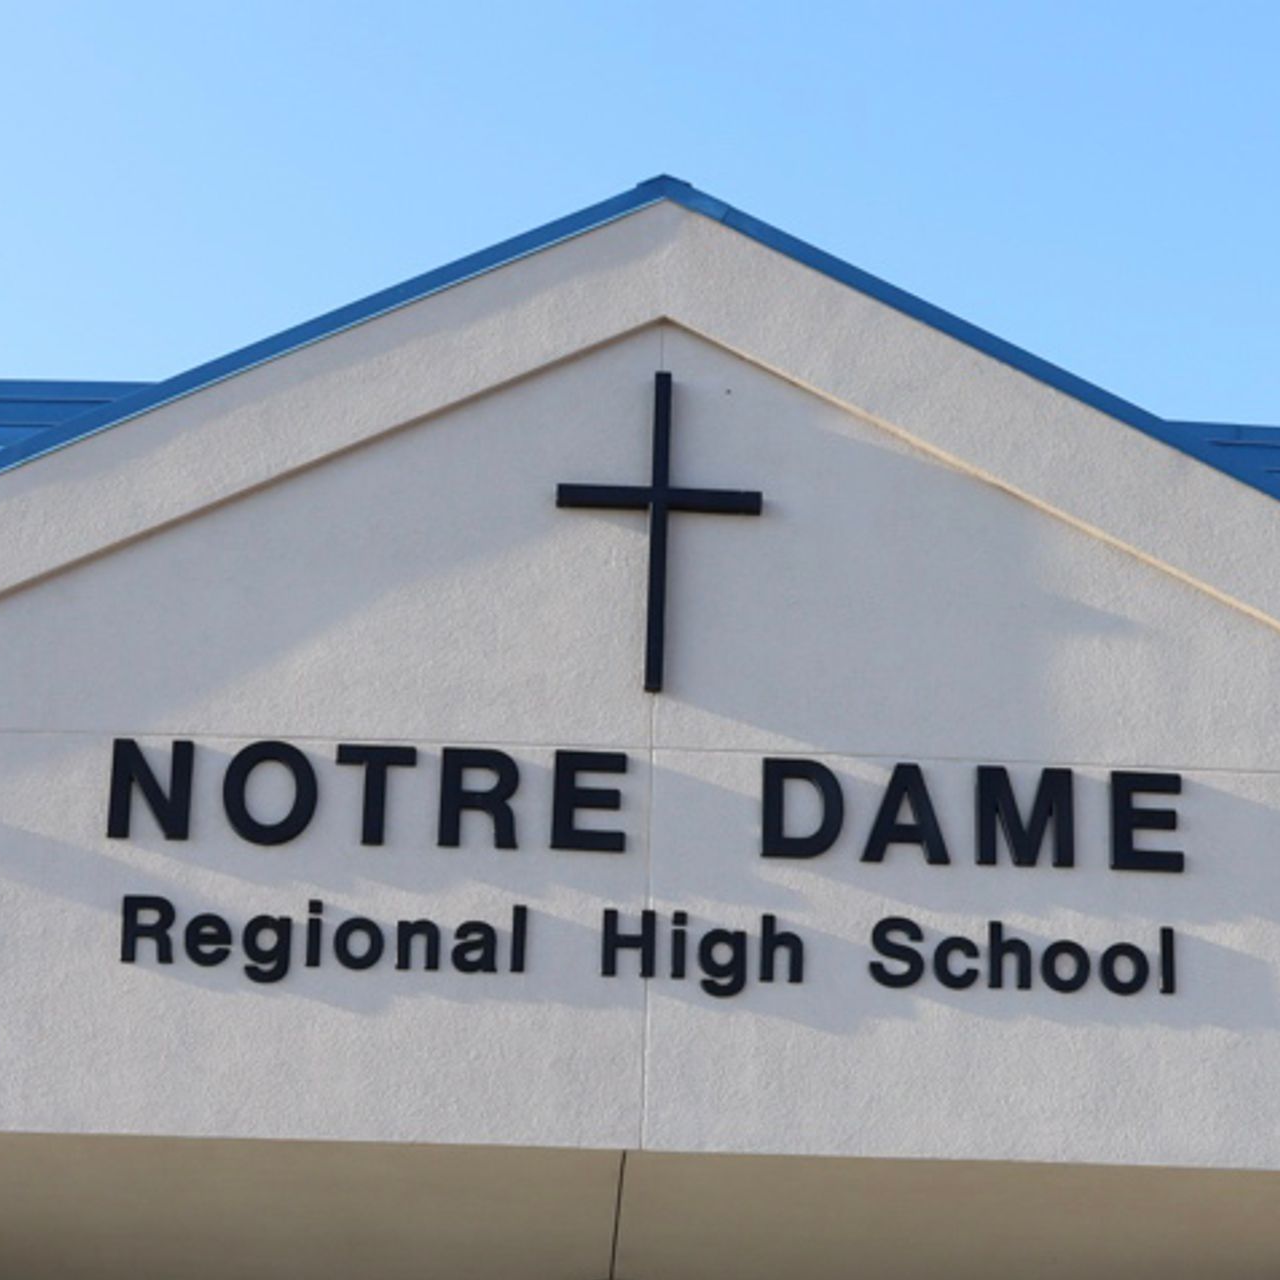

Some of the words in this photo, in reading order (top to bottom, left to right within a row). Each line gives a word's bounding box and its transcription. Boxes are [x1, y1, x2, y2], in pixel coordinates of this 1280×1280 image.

[106, 738, 629, 854] NOTRE
[760, 757, 1185, 874] DAME
[120, 895, 528, 984] Regional
[601, 909, 804, 998] High
[869, 917, 1176, 996] School
